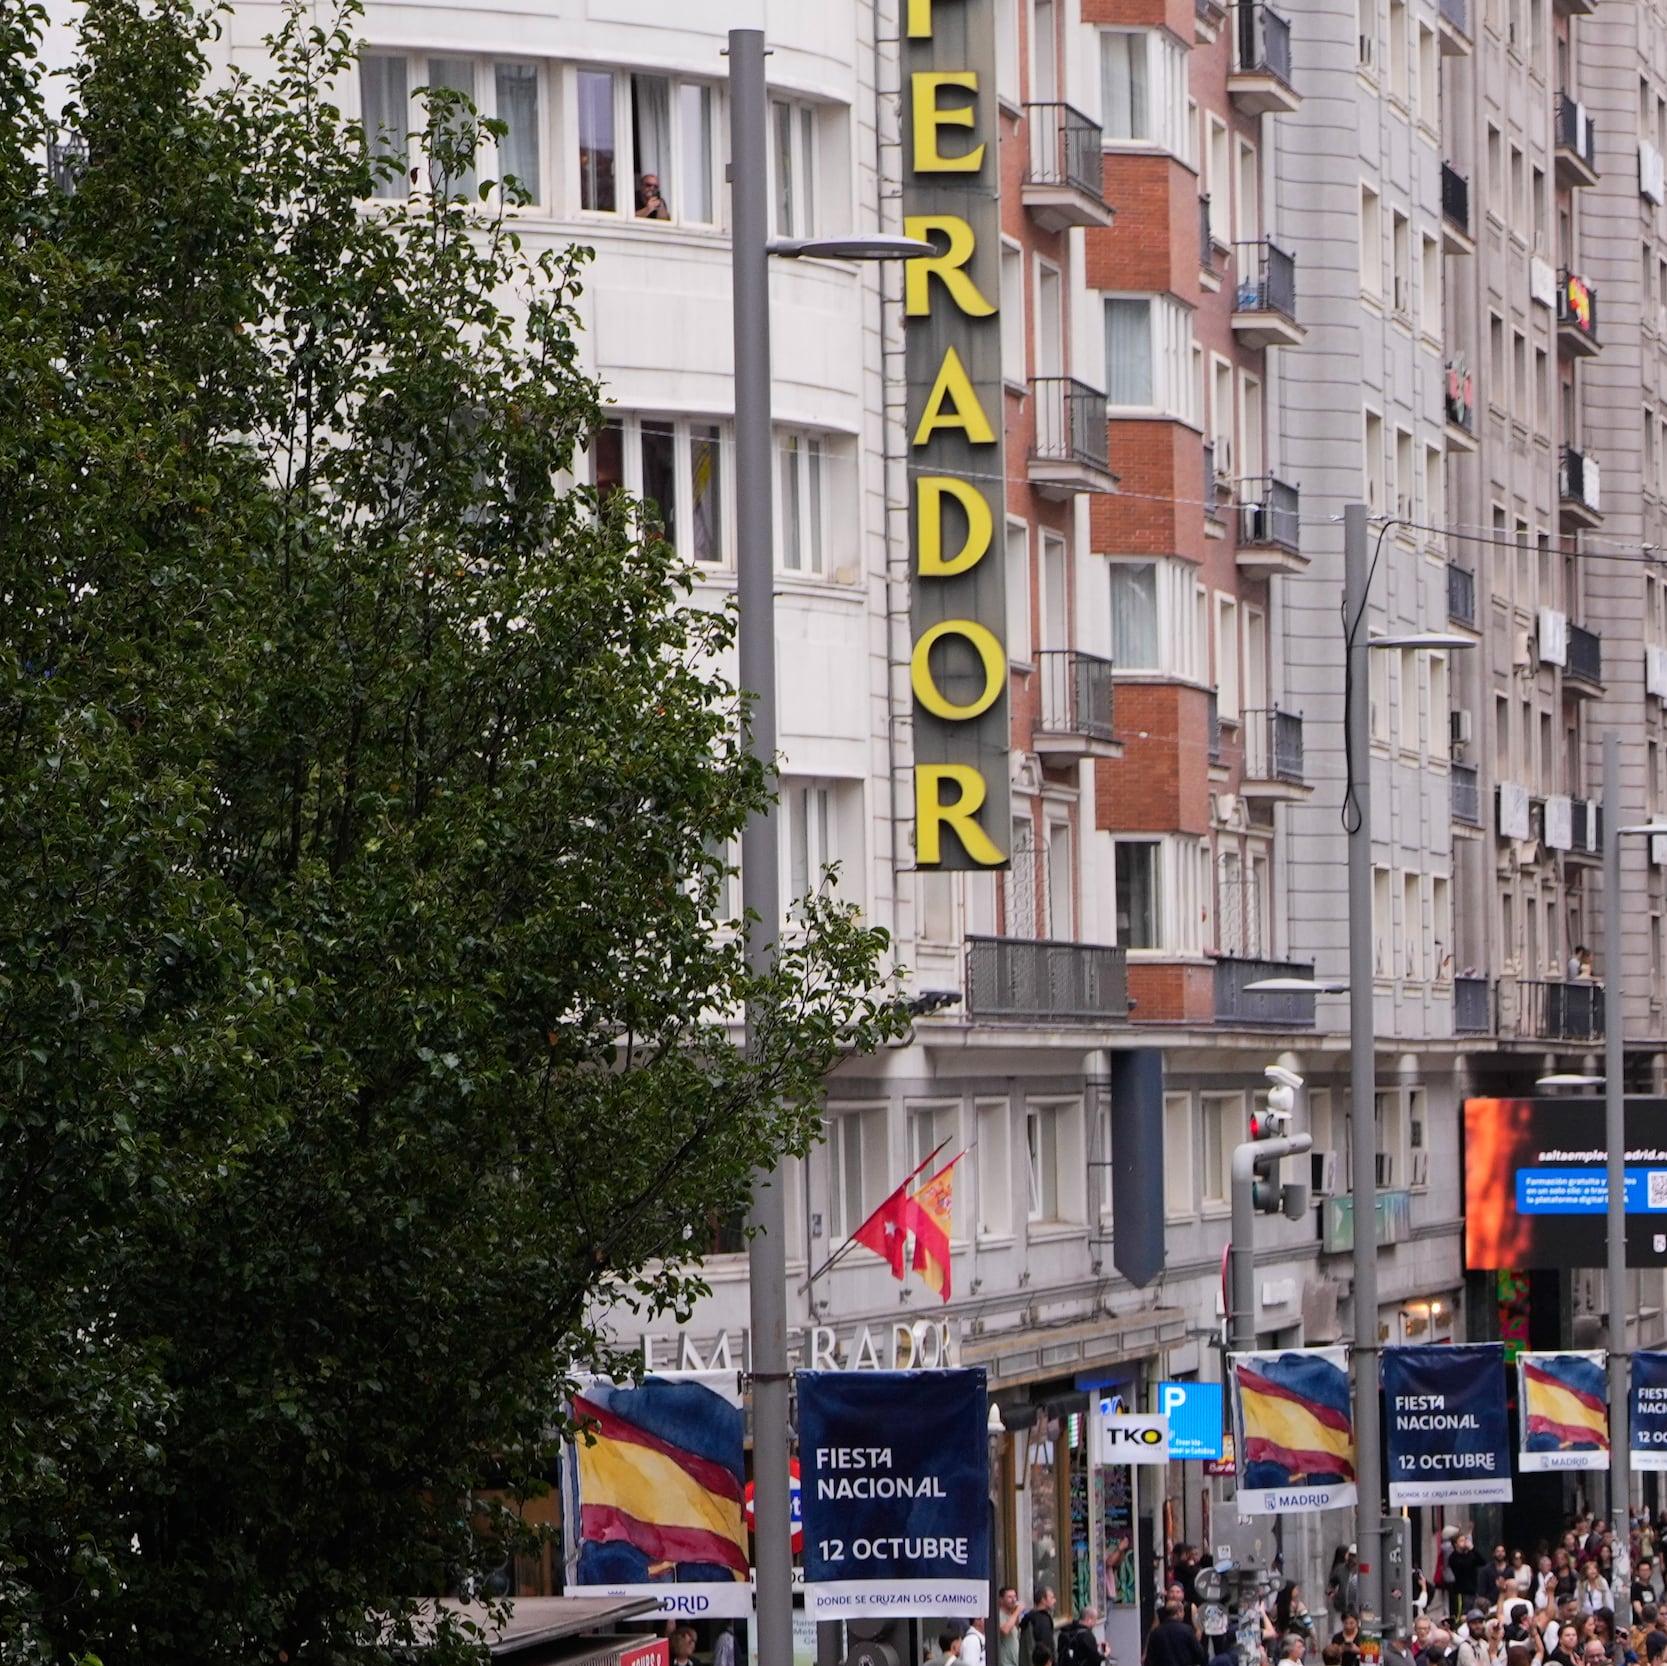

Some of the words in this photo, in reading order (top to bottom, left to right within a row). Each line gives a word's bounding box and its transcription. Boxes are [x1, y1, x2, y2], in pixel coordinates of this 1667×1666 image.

[1164, 1387, 1187, 1418] P
[1396, 1396, 1444, 1411] FIESTA
[1397, 1415, 1479, 1430] NACIONAL
[1107, 1428, 1163, 1445] TKO
[1638, 1431, 1650, 1443] 12
[816, 1447, 892, 1469] FIESTA
[1399, 1455, 1415, 1470] 12
[1420, 1453, 1495, 1470] OCTUBRE
[1551, 1456, 1588, 1467] MADRID
[817, 1477, 946, 1500] NACIONAL
[1279, 1494, 1329, 1507] MADRID
[819, 1540, 843, 1561] 12
[852, 1537, 968, 1565] OCTUBRE
[658, 1595, 710, 1615] DRID
[817, 1595, 852, 1606] DONDE
[854, 1595, 867, 1605] SE
[869, 1595, 911, 1606] CRUZAN
[913, 1594, 932, 1604] LOS
[935, 1594, 978, 1605] CAMINOS
